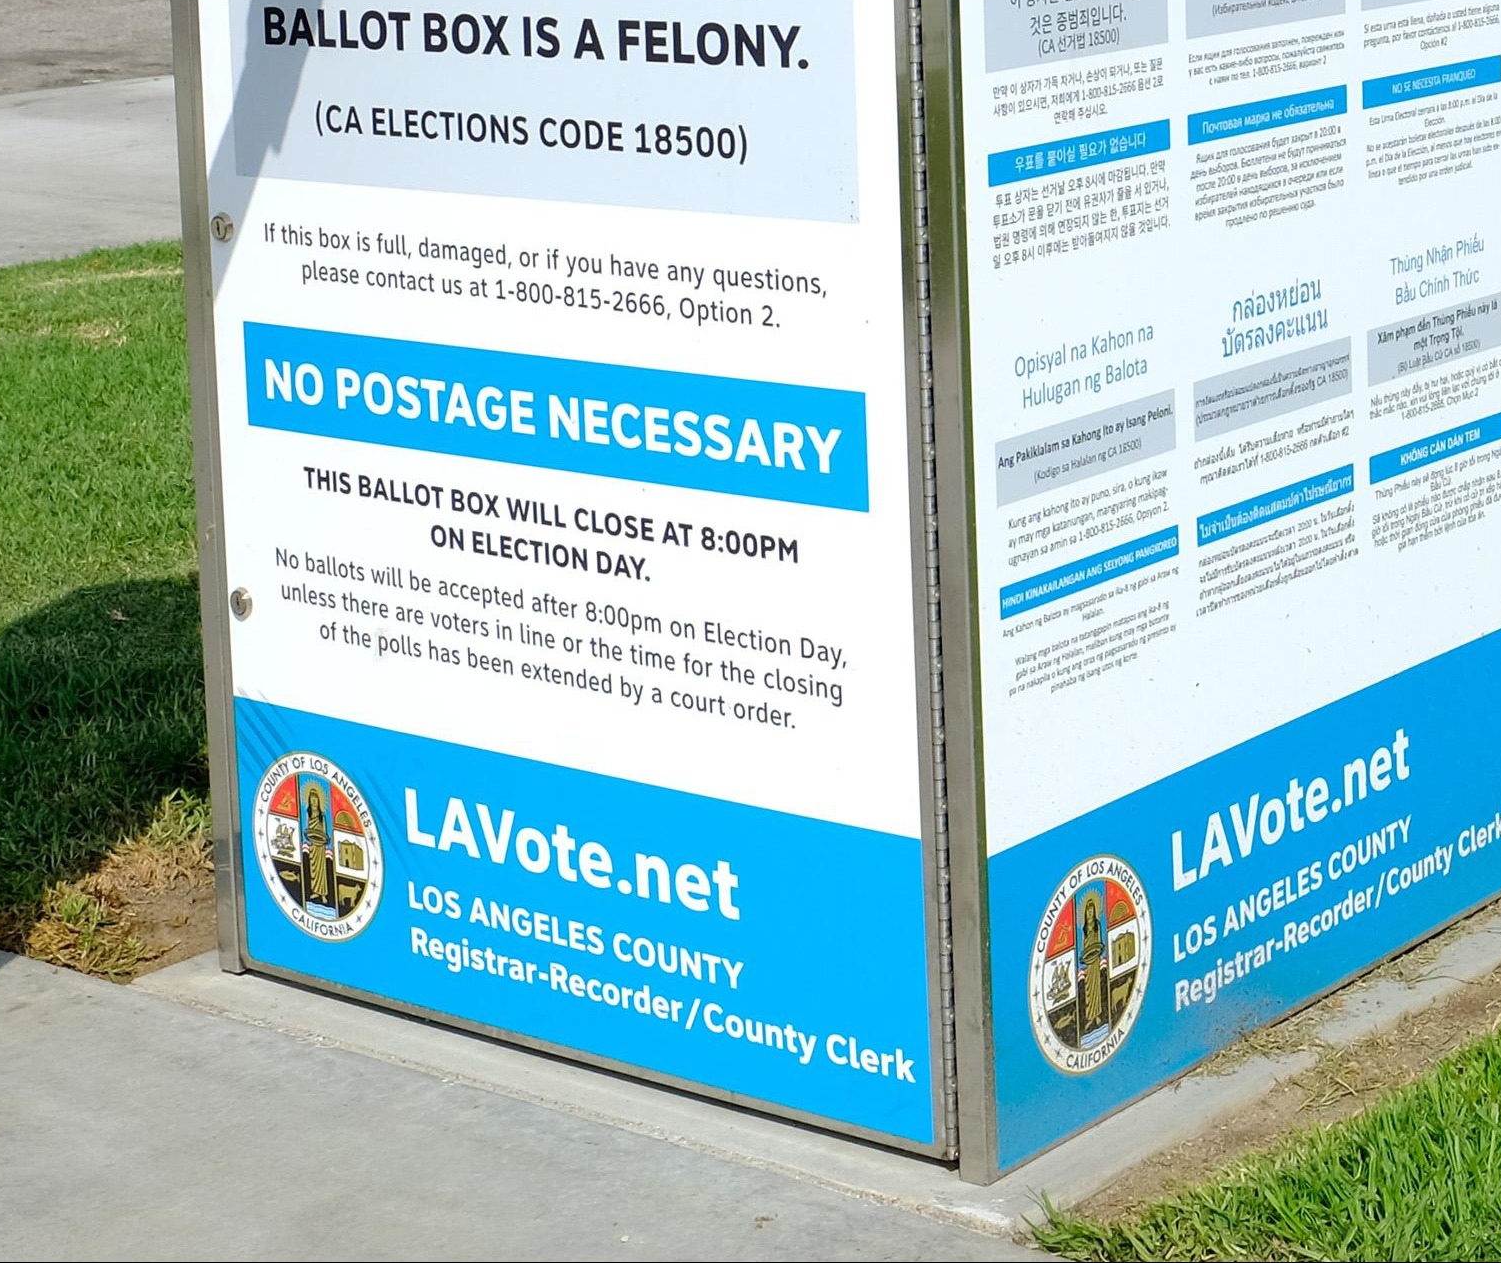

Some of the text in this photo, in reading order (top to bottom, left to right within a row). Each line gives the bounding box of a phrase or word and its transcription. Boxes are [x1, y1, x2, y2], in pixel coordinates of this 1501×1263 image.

[264, 7, 808, 69] BALLOT BOX IS A FELONY.
[1030, 3, 1126, 36] 것은 중범죄입니다.
[316, 101, 747, 165] (CA ELECTIONS CODE 18500)
[265, 223, 826, 298] If this box is full, damaged, or if you have any questions,
[302, 260, 780, 327] please contact us at 1-800-815-2666, Option 2.
[1222, 308, 1328, 358] บัตรลงคะแนน
[1233, 278, 1322, 322] กล่องหย่อน
[1015, 326, 1153, 379] Opisyal na Kahon na
[1023, 359, 1147, 409] Hulugan ng Balota
[265, 359, 841, 473] NO POSTAGE NECESSARY
[304, 467, 798, 563] THIS BALLOT BOX WILL CLOSE AT 8:00PM
[431, 525, 650, 581] ON ELECTION DAY.
[276, 548, 846, 670] No ballots will be accepted after 8:00pm on Election Day,
[282, 584, 845, 707] unless there are voters in line or the time for the closing
[320, 622, 795, 729] of the polls has been extended by a court order.
[260, 756, 373, 829] COUNTY OF LOS ANGELES
[1172, 729, 1409, 891] LAVote.net
[405, 788, 740, 920] LAVote.net
[1174, 816, 1410, 962] LOS ANGELES COUNTY
[291, 907, 355, 937] CALIFORNIA
[409, 881, 743, 989] LOS ANGELES COUNTY
[1037, 861, 1144, 953] COUNTY OF LOS ANGELES
[1175, 844, 1453, 1012] Registrar-Recorder/County
[411, 927, 915, 1083] Registrar-Recorder/County Clerk
[1065, 1028, 1126, 1070] CALIFORNIA
